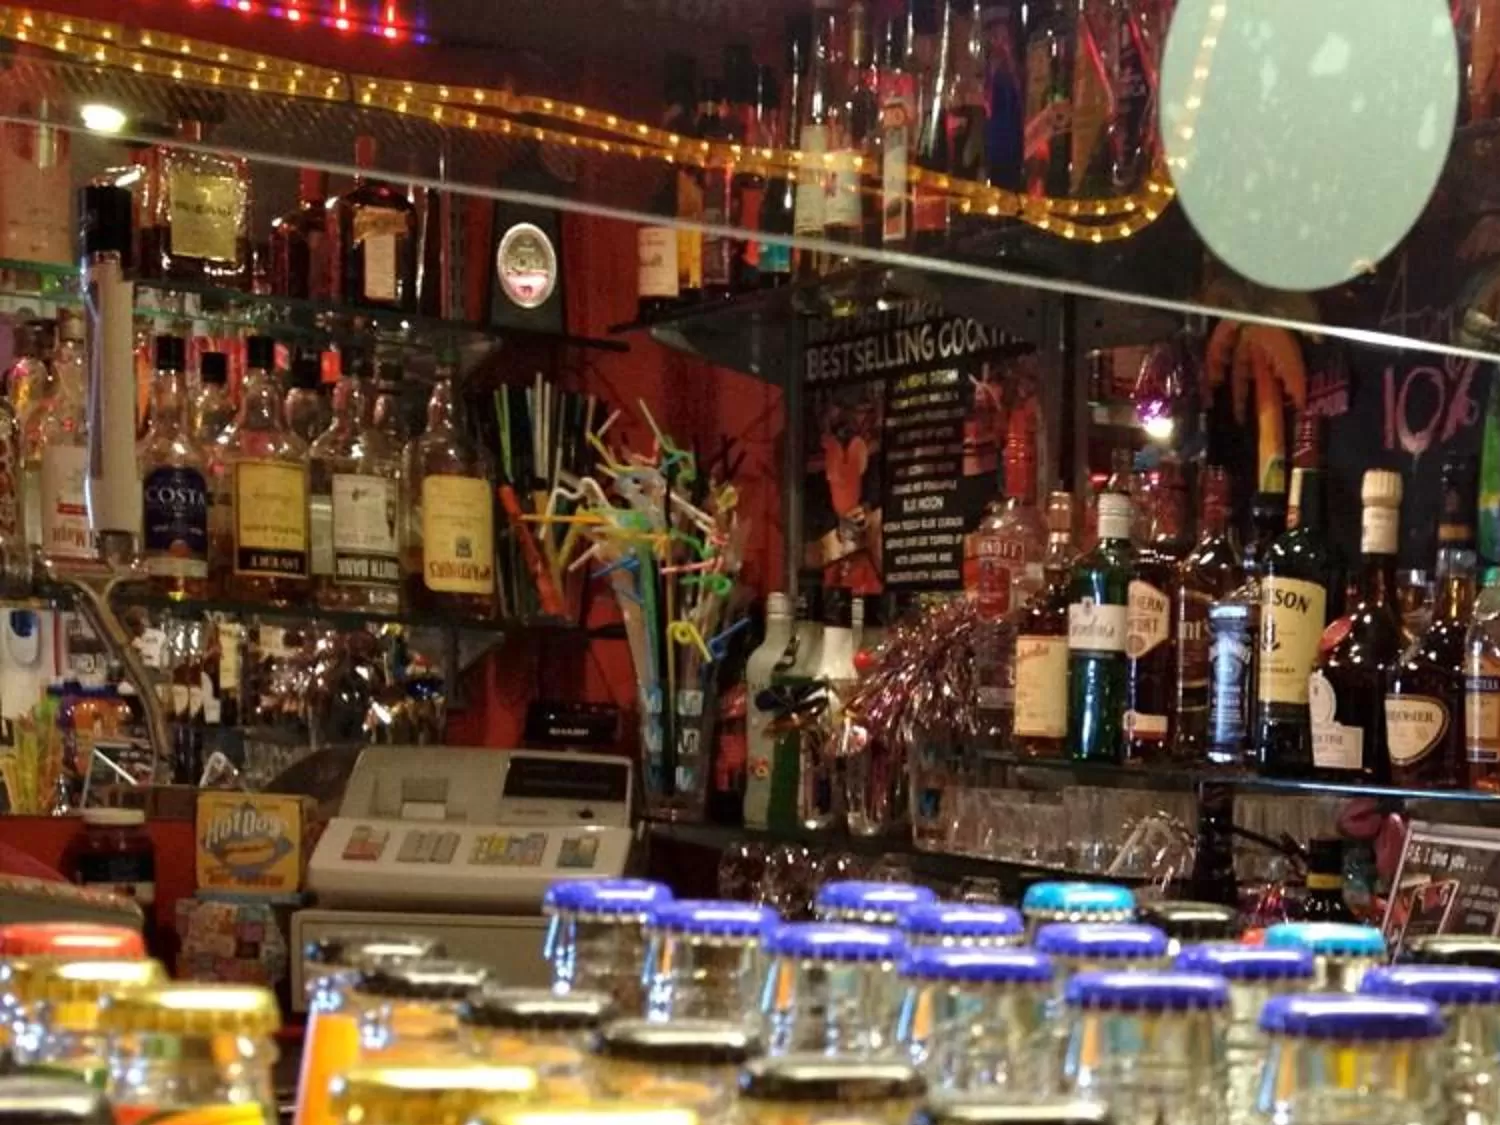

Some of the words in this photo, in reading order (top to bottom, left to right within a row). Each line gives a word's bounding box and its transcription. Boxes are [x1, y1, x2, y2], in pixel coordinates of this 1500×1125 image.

[806, 346, 851, 381] BEST
[853, 323, 936, 374] SELLING
[1274, 587, 1313, 615] SON
